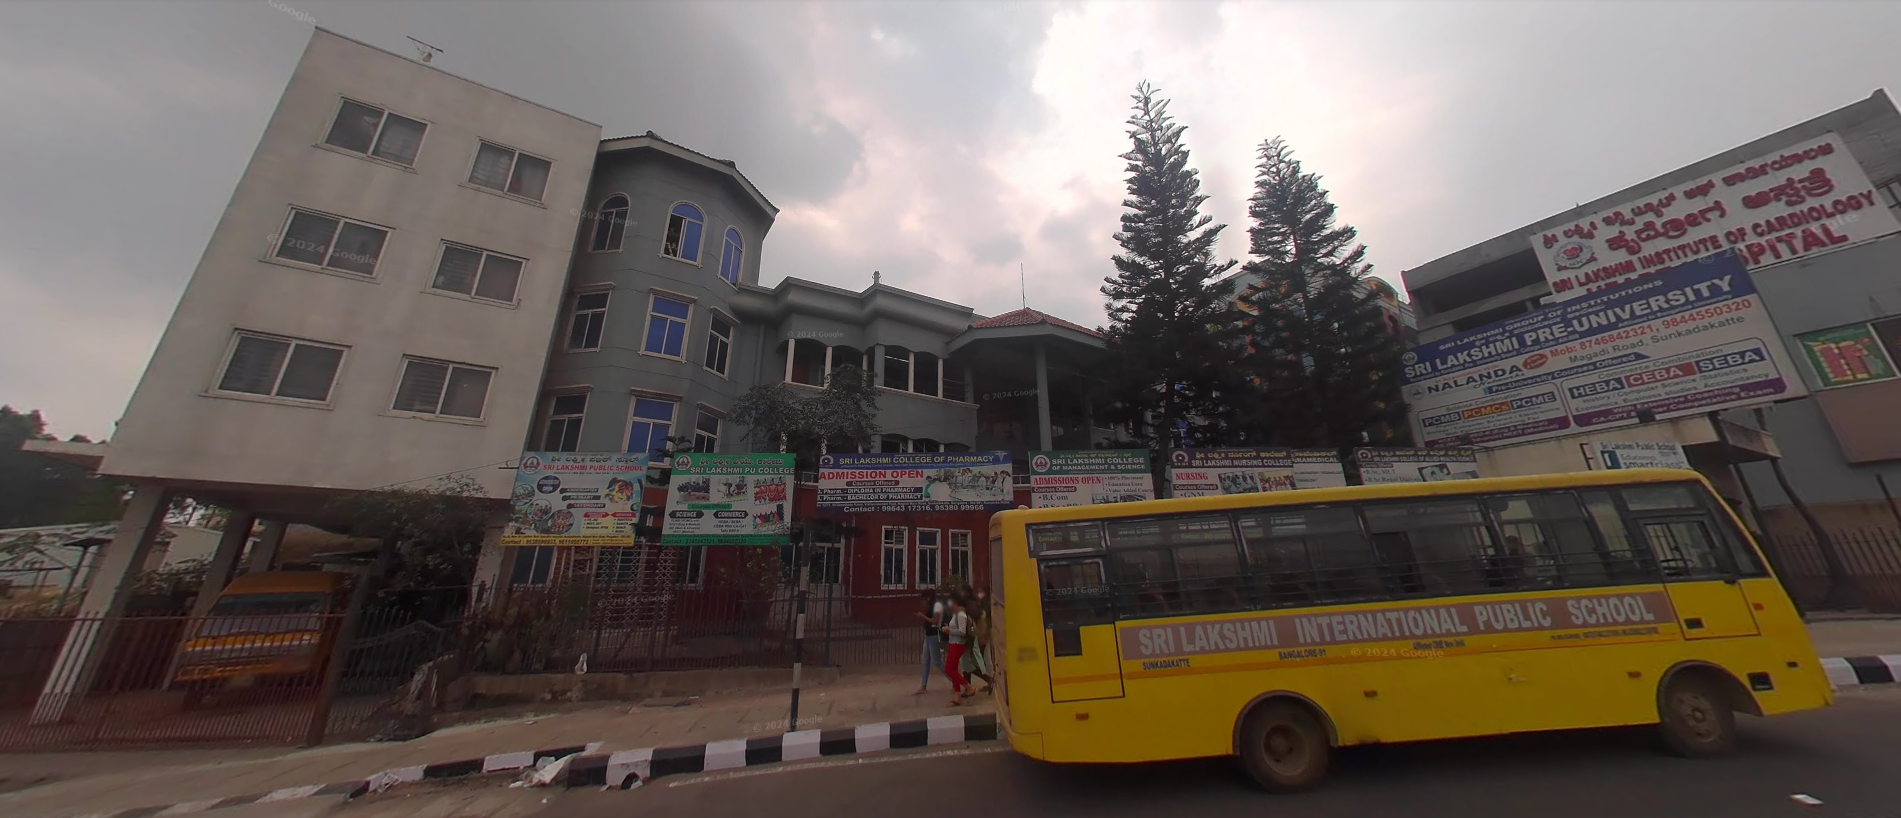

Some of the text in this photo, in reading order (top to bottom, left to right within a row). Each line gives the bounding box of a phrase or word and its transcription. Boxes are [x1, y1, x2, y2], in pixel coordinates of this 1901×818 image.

[1552, 279, 1573, 294] SRI
[1575, 260, 1637, 285] LAKSHMI
[1640, 235, 1722, 269] INSTITUTE
[1724, 227, 1748, 245] OF
[1752, 190, 1874, 237] CARDIOLOGY
[1404, 361, 1431, 378] SRI
[1435, 335, 1519, 369] LAKSHMI
[1523, 273, 1737, 346] PRE-UNIVERSITY
[1439, 341, 1454, 350] SRI
[1457, 326, 1502, 344] LAKSHMI
[1505, 314, 1545, 331] GROUP
[1547, 308, 1564, 318] OF
[1566, 278, 1663, 312] INSTITUTIONS
[1549, 298, 1753, 357] Mob: 8746842321, 9844550320
[1568, 347, 1610, 364] Magadi
[1611, 338, 1648, 353] Road,
[1649, 313, 1745, 343] Sunkadakatte
[1427, 363, 1522, 393] NALANDA
[1491, 354, 1635, 392] Pre-University Courses Offered
[1571, 350, 1761, 396] HEBA CEBA SEBA
[1597, 348, 1723, 379] Commerce Combination
[1612, 405, 1634, 413] With
[1687, 386, 1740, 400] Coaching
[1740, 387, 1774, 397] Exam
[1424, 393, 1554, 425] PCMB PCMCs PCME
[556, 464, 587, 472] LAKSHMI
[615, 464, 643, 472] SCHOOL
[819, 469, 924, 481] ADMISSION OPEN
[1175, 472, 1208, 481] NURSING
[1263, 458, 1292, 466] COLLEGE
[1033, 476, 1101, 485] ADMISSIONS OPEN
[1138, 595, 1654, 655] SRI LAKSHMI INTERNATIONAL PUBLIC SCHOOL
[1142, 658, 1190, 670] SUNKADAKATTE
[1278, 648, 1327, 661] BANGALORE-91
